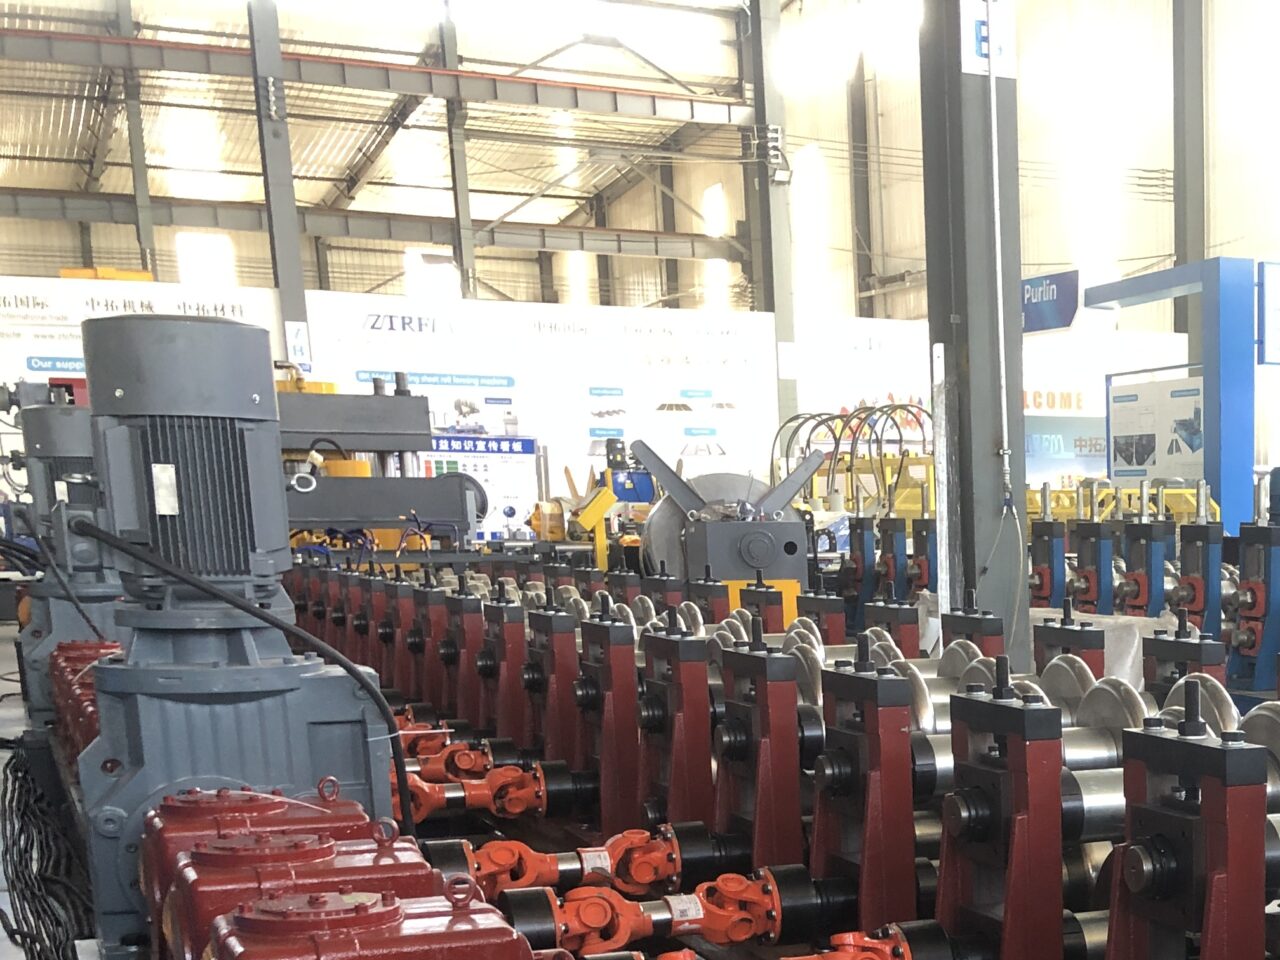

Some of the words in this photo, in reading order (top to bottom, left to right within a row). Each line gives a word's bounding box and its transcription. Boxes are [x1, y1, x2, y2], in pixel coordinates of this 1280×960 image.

[1024, 280, 1057, 304] Purlin
[31, 358, 52, 368] Our
[1073, 436, 1106, 454] 中拓
